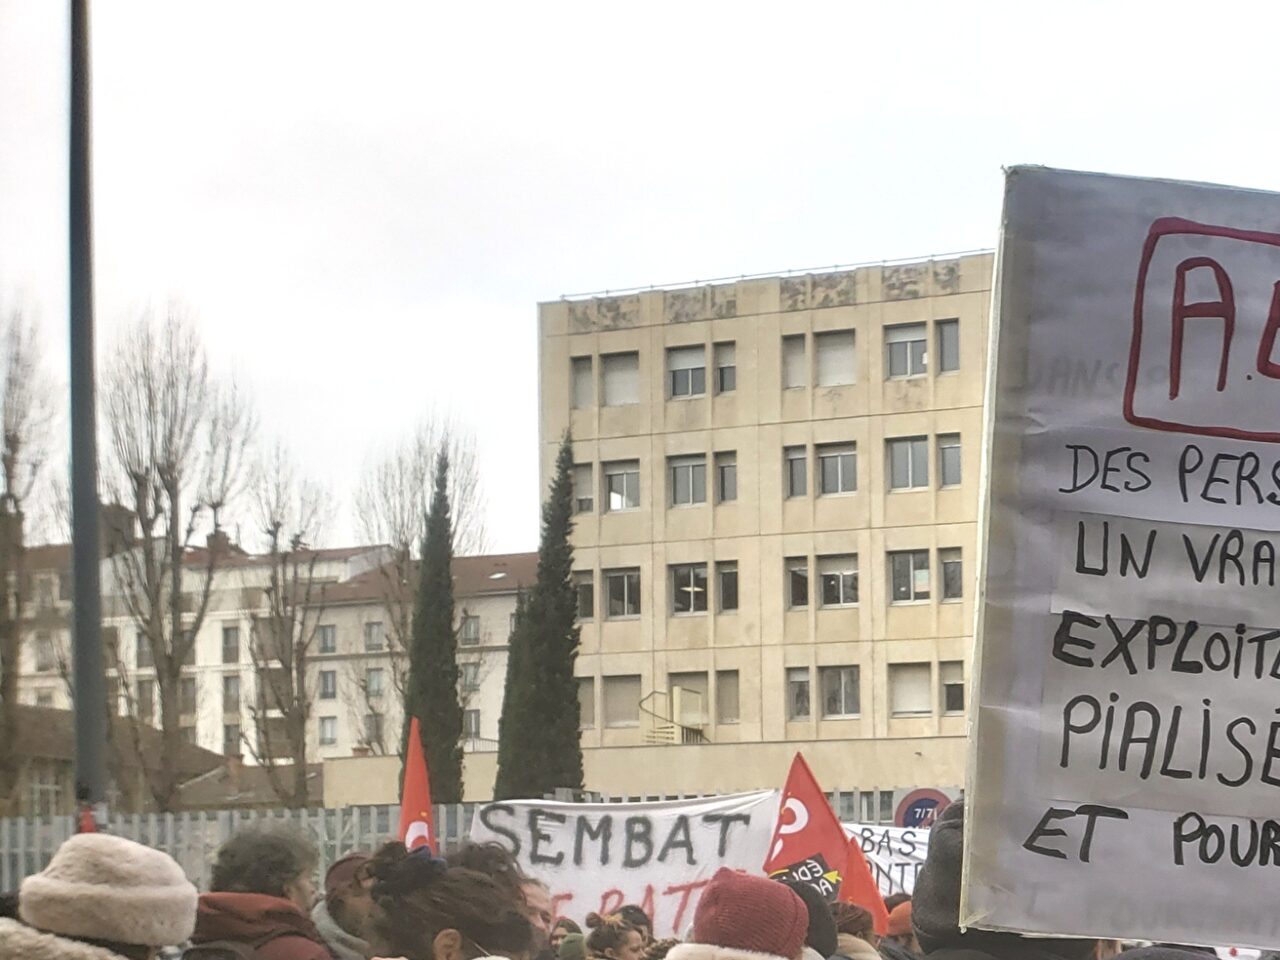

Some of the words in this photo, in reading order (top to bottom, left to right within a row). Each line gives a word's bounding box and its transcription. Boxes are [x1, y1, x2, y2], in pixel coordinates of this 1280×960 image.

[1059, 443, 1153, 494] DES
[1075, 520, 1157, 579] UN
[480, 804, 750, 868] SEMBAT
[860, 827, 919, 857] BAS
[1022, 804, 1129, 862] ET
